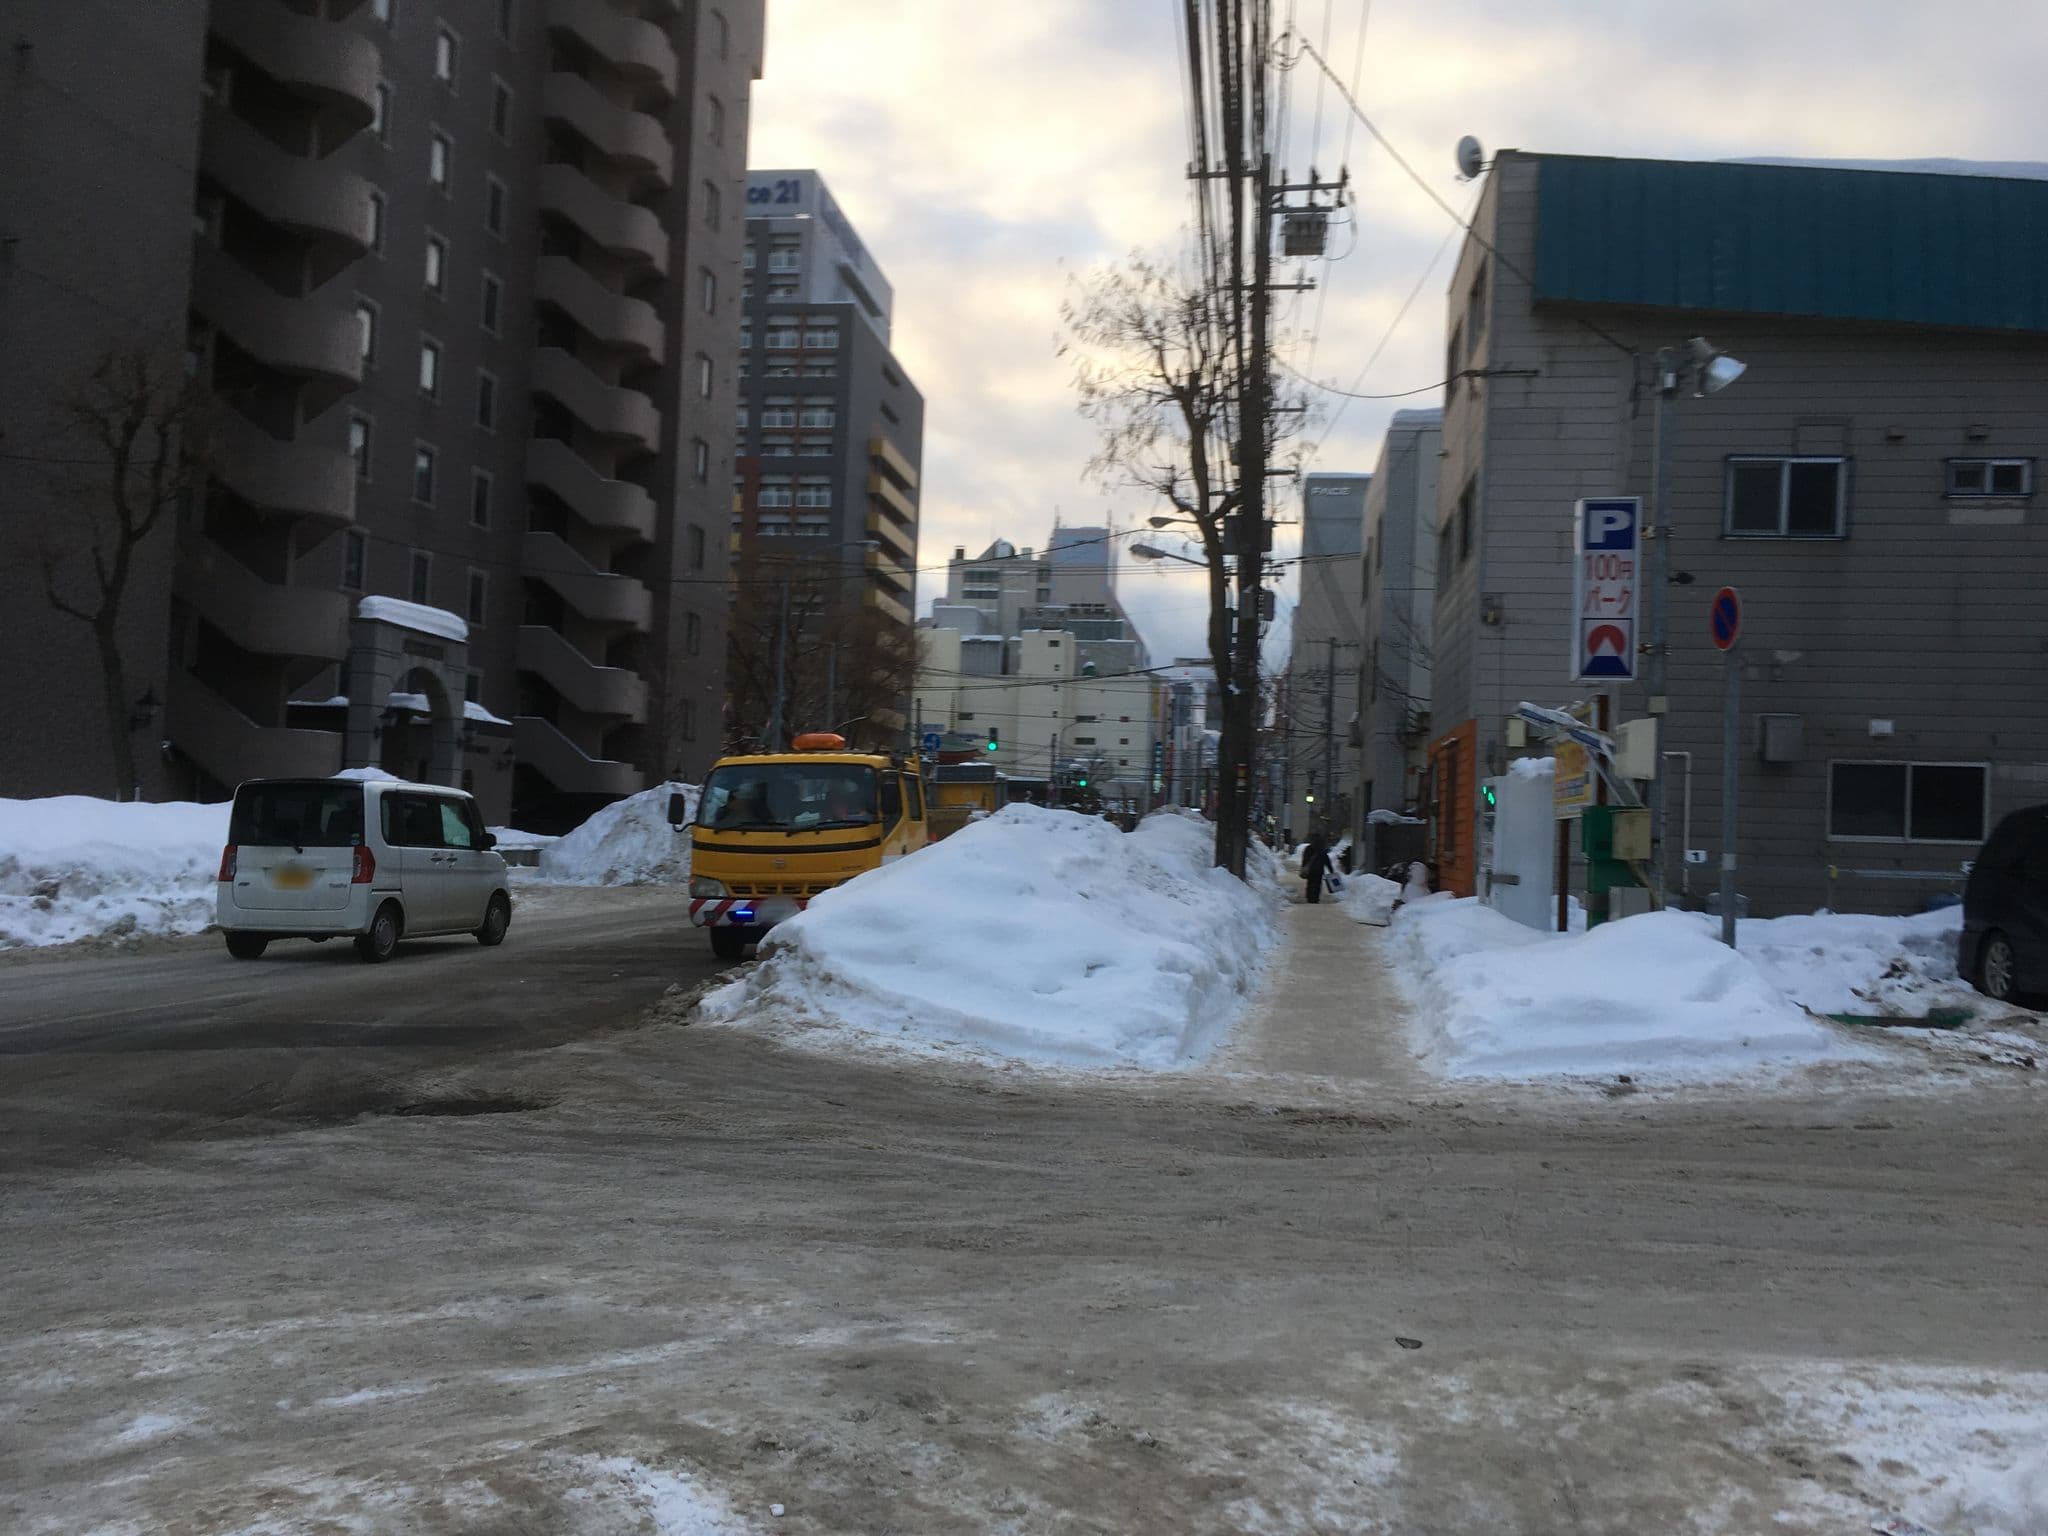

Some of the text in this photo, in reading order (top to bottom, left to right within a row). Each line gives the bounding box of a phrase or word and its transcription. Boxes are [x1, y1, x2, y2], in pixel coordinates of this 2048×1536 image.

[775, 179, 801, 204] 21
[1588, 510, 1631, 544] P
[1584, 585, 1633, 615] パーク
